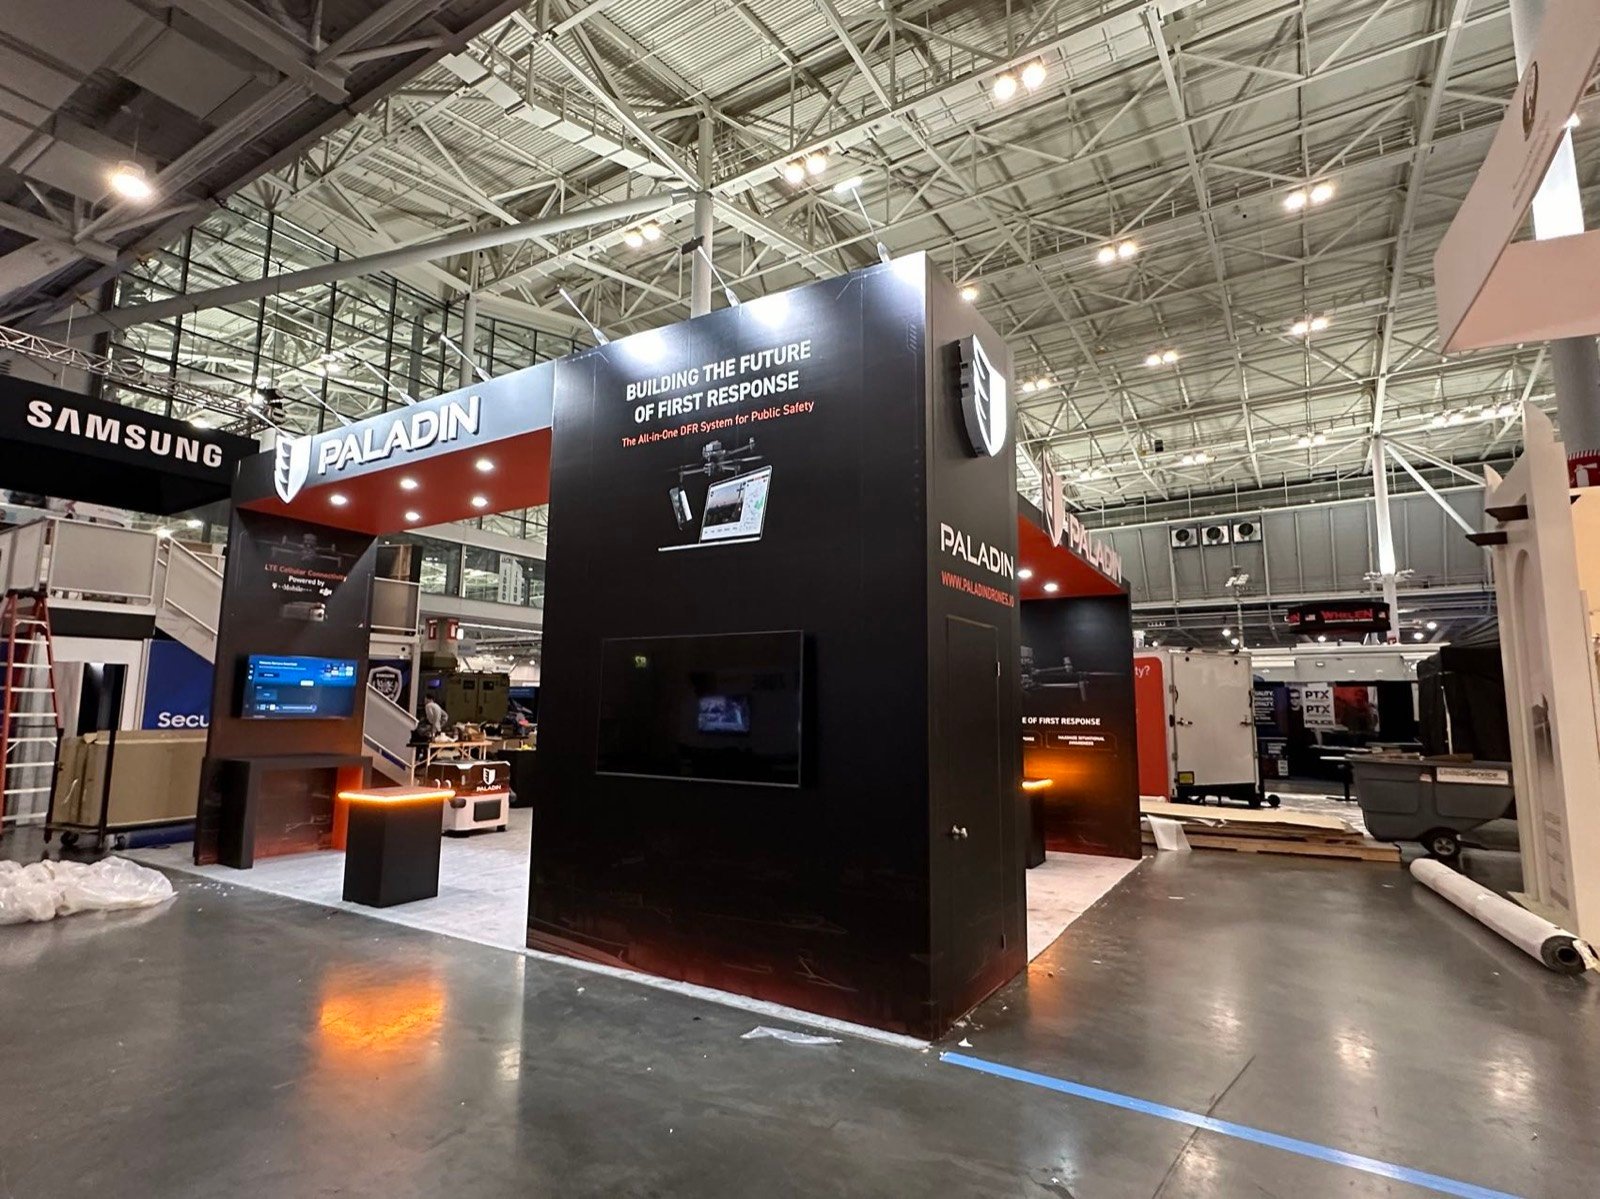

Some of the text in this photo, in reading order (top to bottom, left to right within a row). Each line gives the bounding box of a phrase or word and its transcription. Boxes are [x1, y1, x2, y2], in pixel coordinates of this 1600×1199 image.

[626, 340, 812, 401] BUILDING THE FUTURE
[634, 370, 799, 423] OF FIRST RESPONSE
[26, 400, 223, 469] SAMSUNG
[318, 395, 481, 475] PALADIN
[622, 401, 815, 448] The All-in-One DFR System for Public Safety
[264, 563, 279, 572] LTE
[280, 566, 306, 576] Cellular
[940, 522, 1014, 580] PALADIN
[1069, 513, 1122, 584] PALADIN
[288, 575, 325, 587] Powered by
[941, 570, 1015, 608] WWW.PALADINDRONES.IO
[1305, 690, 1329, 699] PTX
[1306, 705, 1331, 714] PTX
[1027, 716, 1038, 724] OF
[1039, 717, 1060, 725] FIRST
[1061, 717, 1101, 726] RESPONSE
[476, 784, 502, 792] PALADIN
